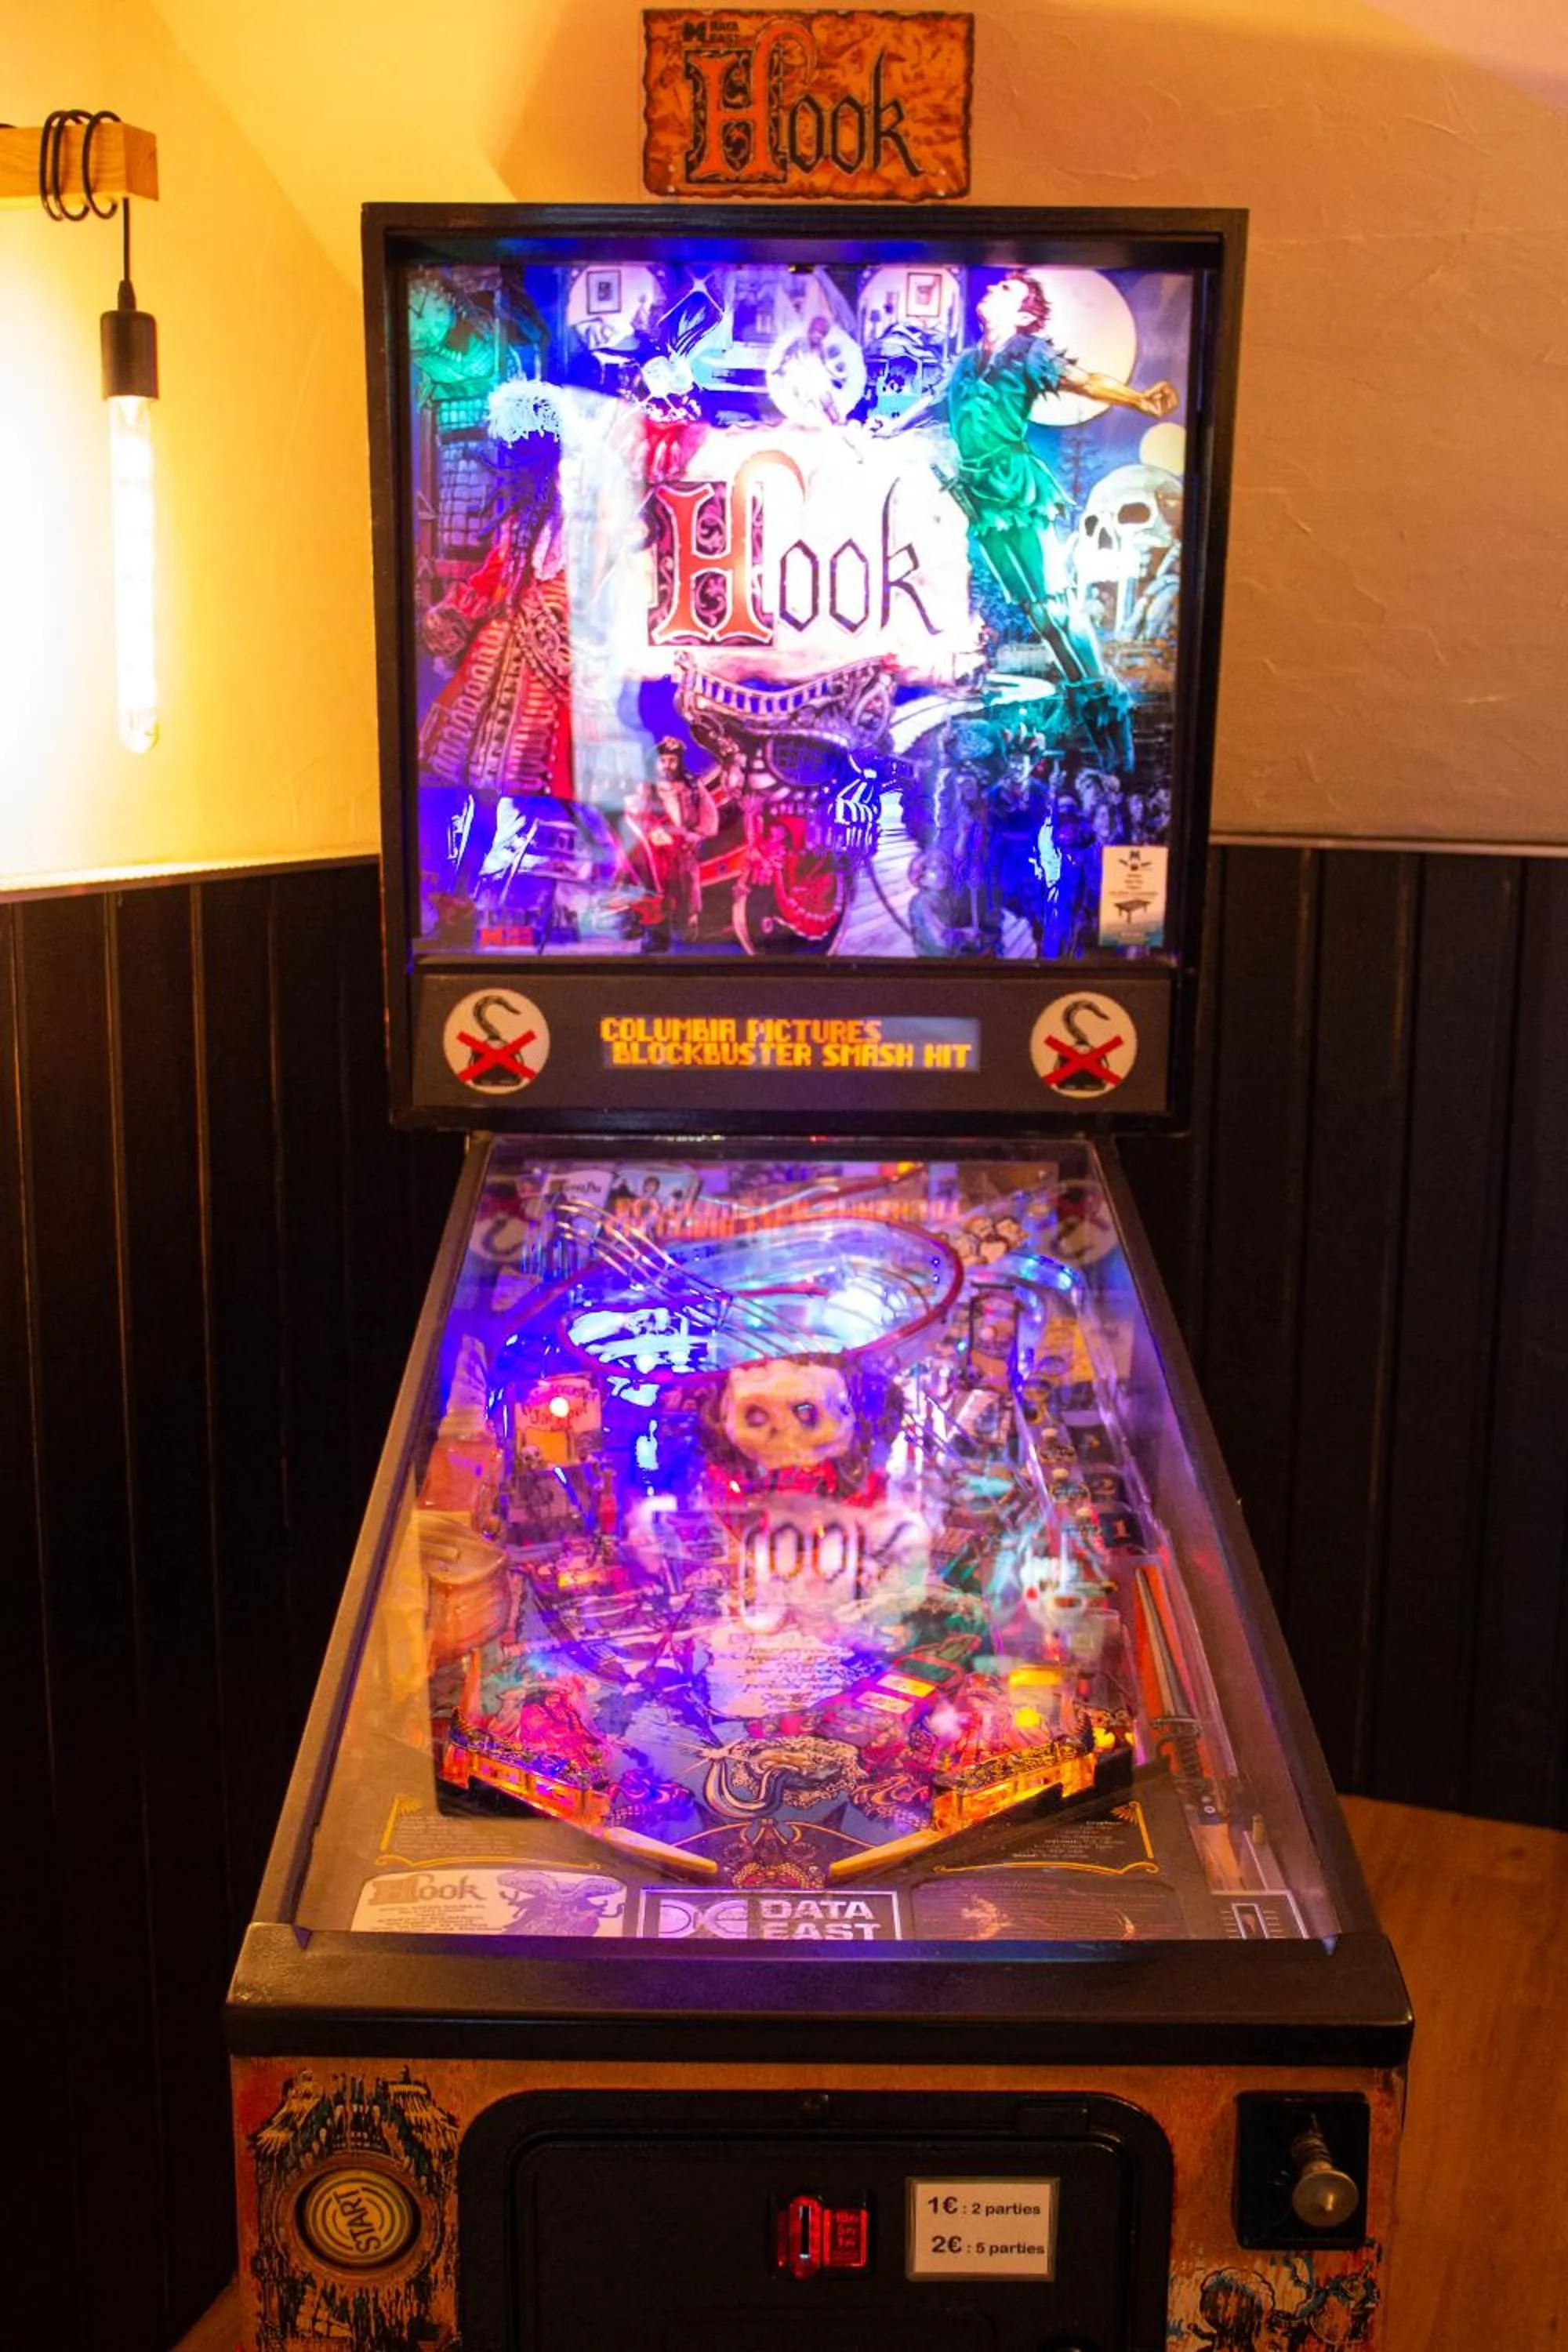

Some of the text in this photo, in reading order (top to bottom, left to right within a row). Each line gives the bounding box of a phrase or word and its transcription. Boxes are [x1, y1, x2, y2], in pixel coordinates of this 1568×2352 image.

[684, 19, 924, 183] Hook
[648, 449, 942, 646] Hook
[601, 1017, 881, 1044] COLUMBIA PICTURES
[612, 1042, 971, 1069] BLOCKBUSTER SMASH HIT
[760, 1900, 874, 1920] DATA
[760, 1922, 880, 1940] EAST
[927, 2196, 958, 2215] 1€
[971, 2203, 981, 2215] 2
[985, 2202, 1040, 2217] parties
[333, 2189, 382, 2254] START
[931, 2235, 962, 2254] 2€
[989, 2242, 1045, 2256] parties
